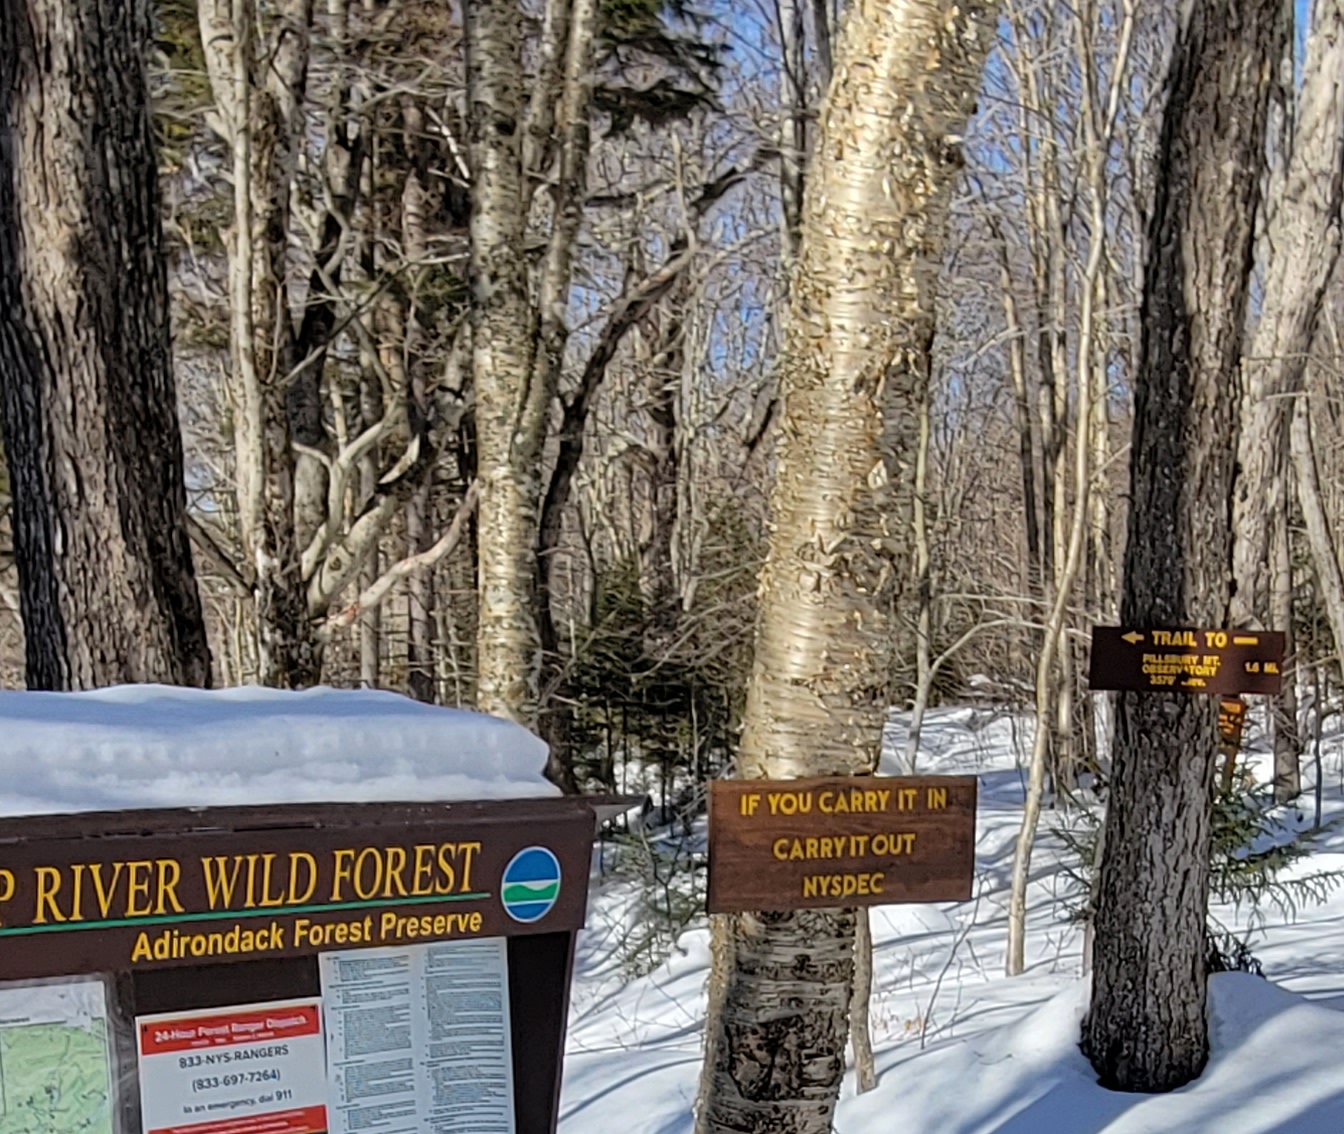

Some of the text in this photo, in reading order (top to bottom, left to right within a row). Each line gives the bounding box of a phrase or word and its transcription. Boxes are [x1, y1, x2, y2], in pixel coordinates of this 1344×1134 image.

[1151, 631, 1227, 648] TRAIL TO
[740, 788, 947, 816] IF YOU CARRY IT IN
[773, 833, 916, 860] CARRY IT OUT
[32, 859, 185, 923] RIVER
[202, 851, 318, 909] WILD
[329, 842, 482, 900] FOREST
[803, 873, 885, 897] NYSDEC
[131, 910, 483, 962] Adirondack Forest Preserve
[179, 1044, 289, 1069] 833-NYS-RANGERS
[192, 1069, 281, 1093] (833-697-7264)
[276, 1089, 292, 1101] 911
